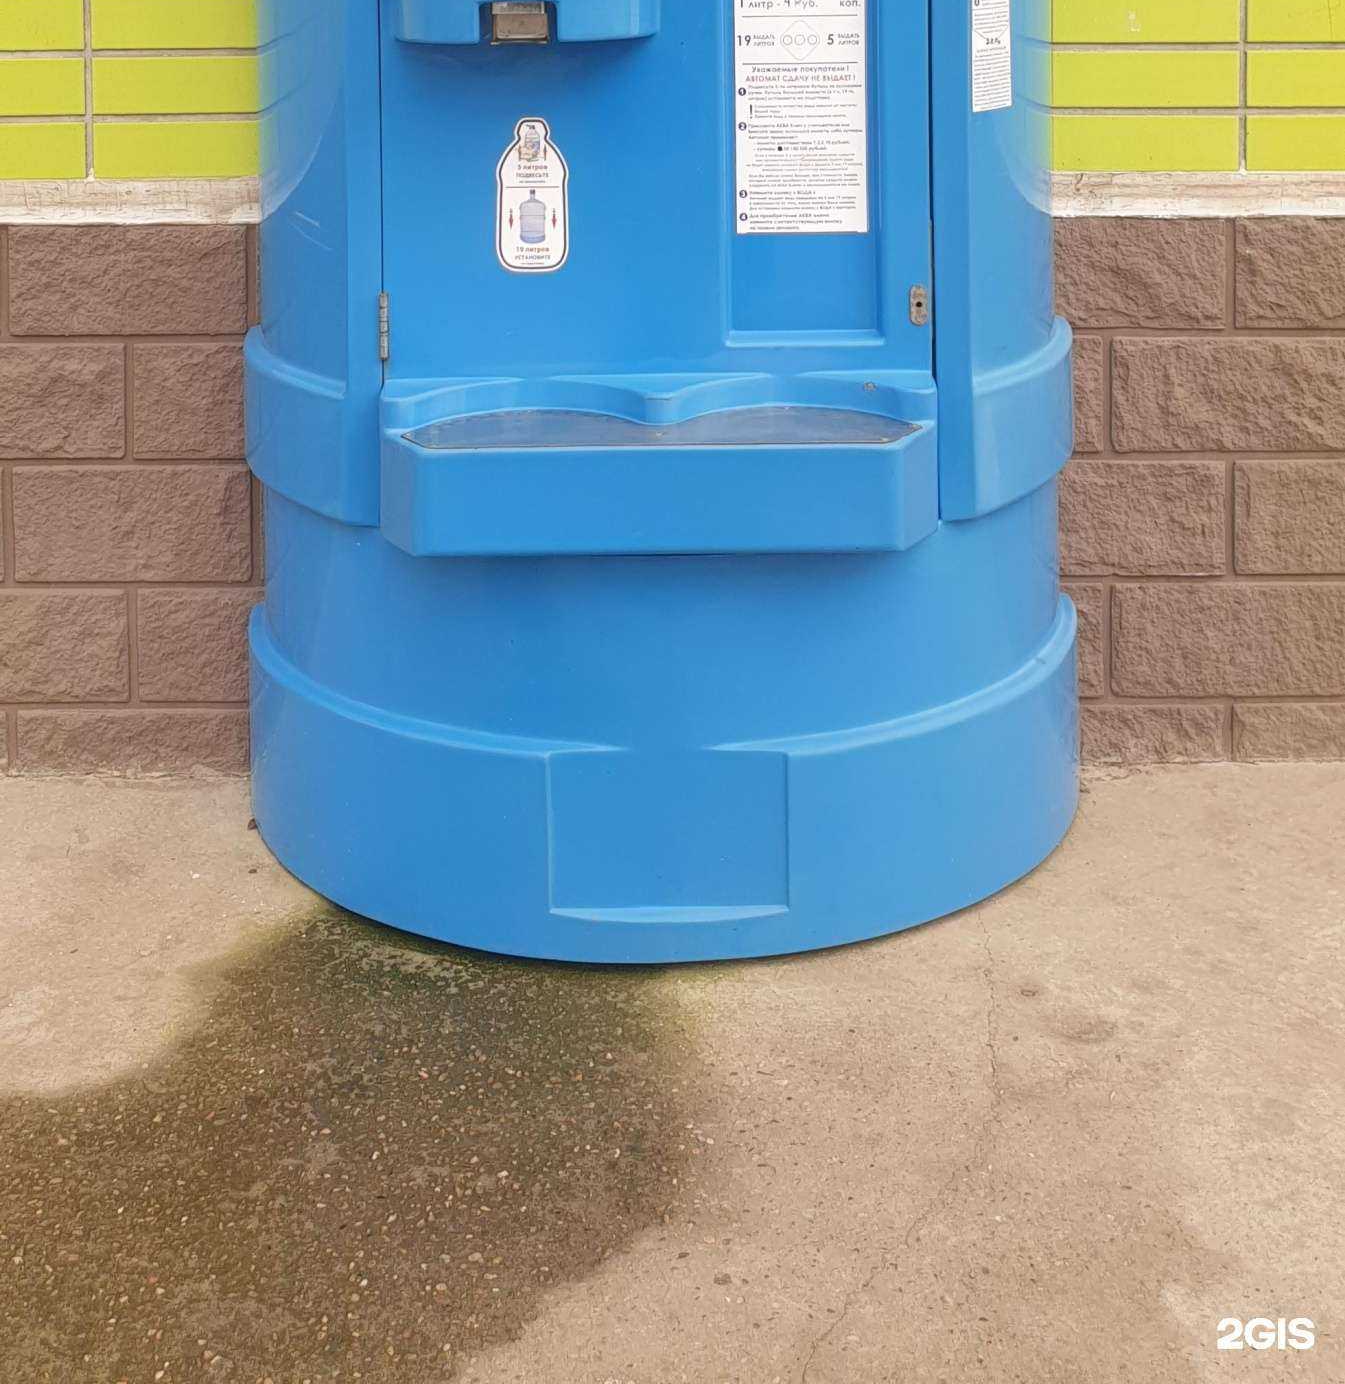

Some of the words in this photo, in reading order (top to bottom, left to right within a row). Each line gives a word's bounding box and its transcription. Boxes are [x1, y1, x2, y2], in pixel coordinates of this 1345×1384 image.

[748, 0, 774, 10] литр
[839, 0, 861, 8] коп.
[737, 35, 752, 47] 19
[827, 33, 834, 45] 5
